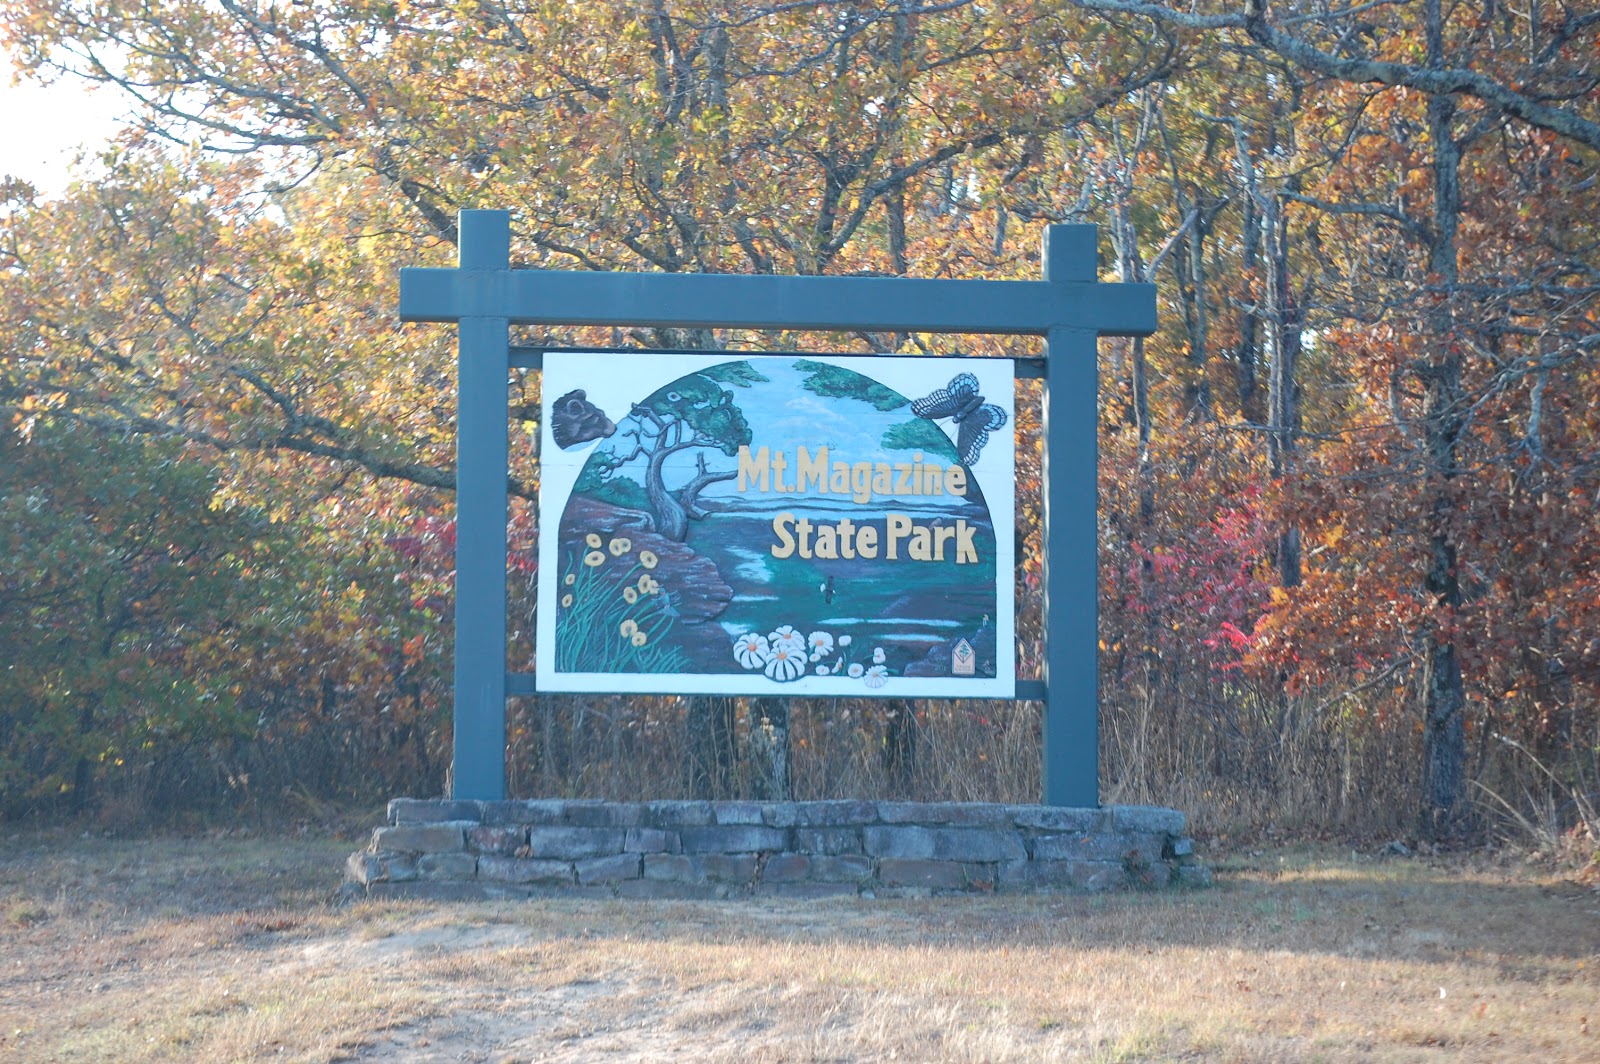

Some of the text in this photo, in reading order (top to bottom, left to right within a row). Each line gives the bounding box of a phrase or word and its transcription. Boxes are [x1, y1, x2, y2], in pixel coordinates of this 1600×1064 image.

[797, 445, 967, 504] Magazine
[771, 512, 979, 564] State Park
